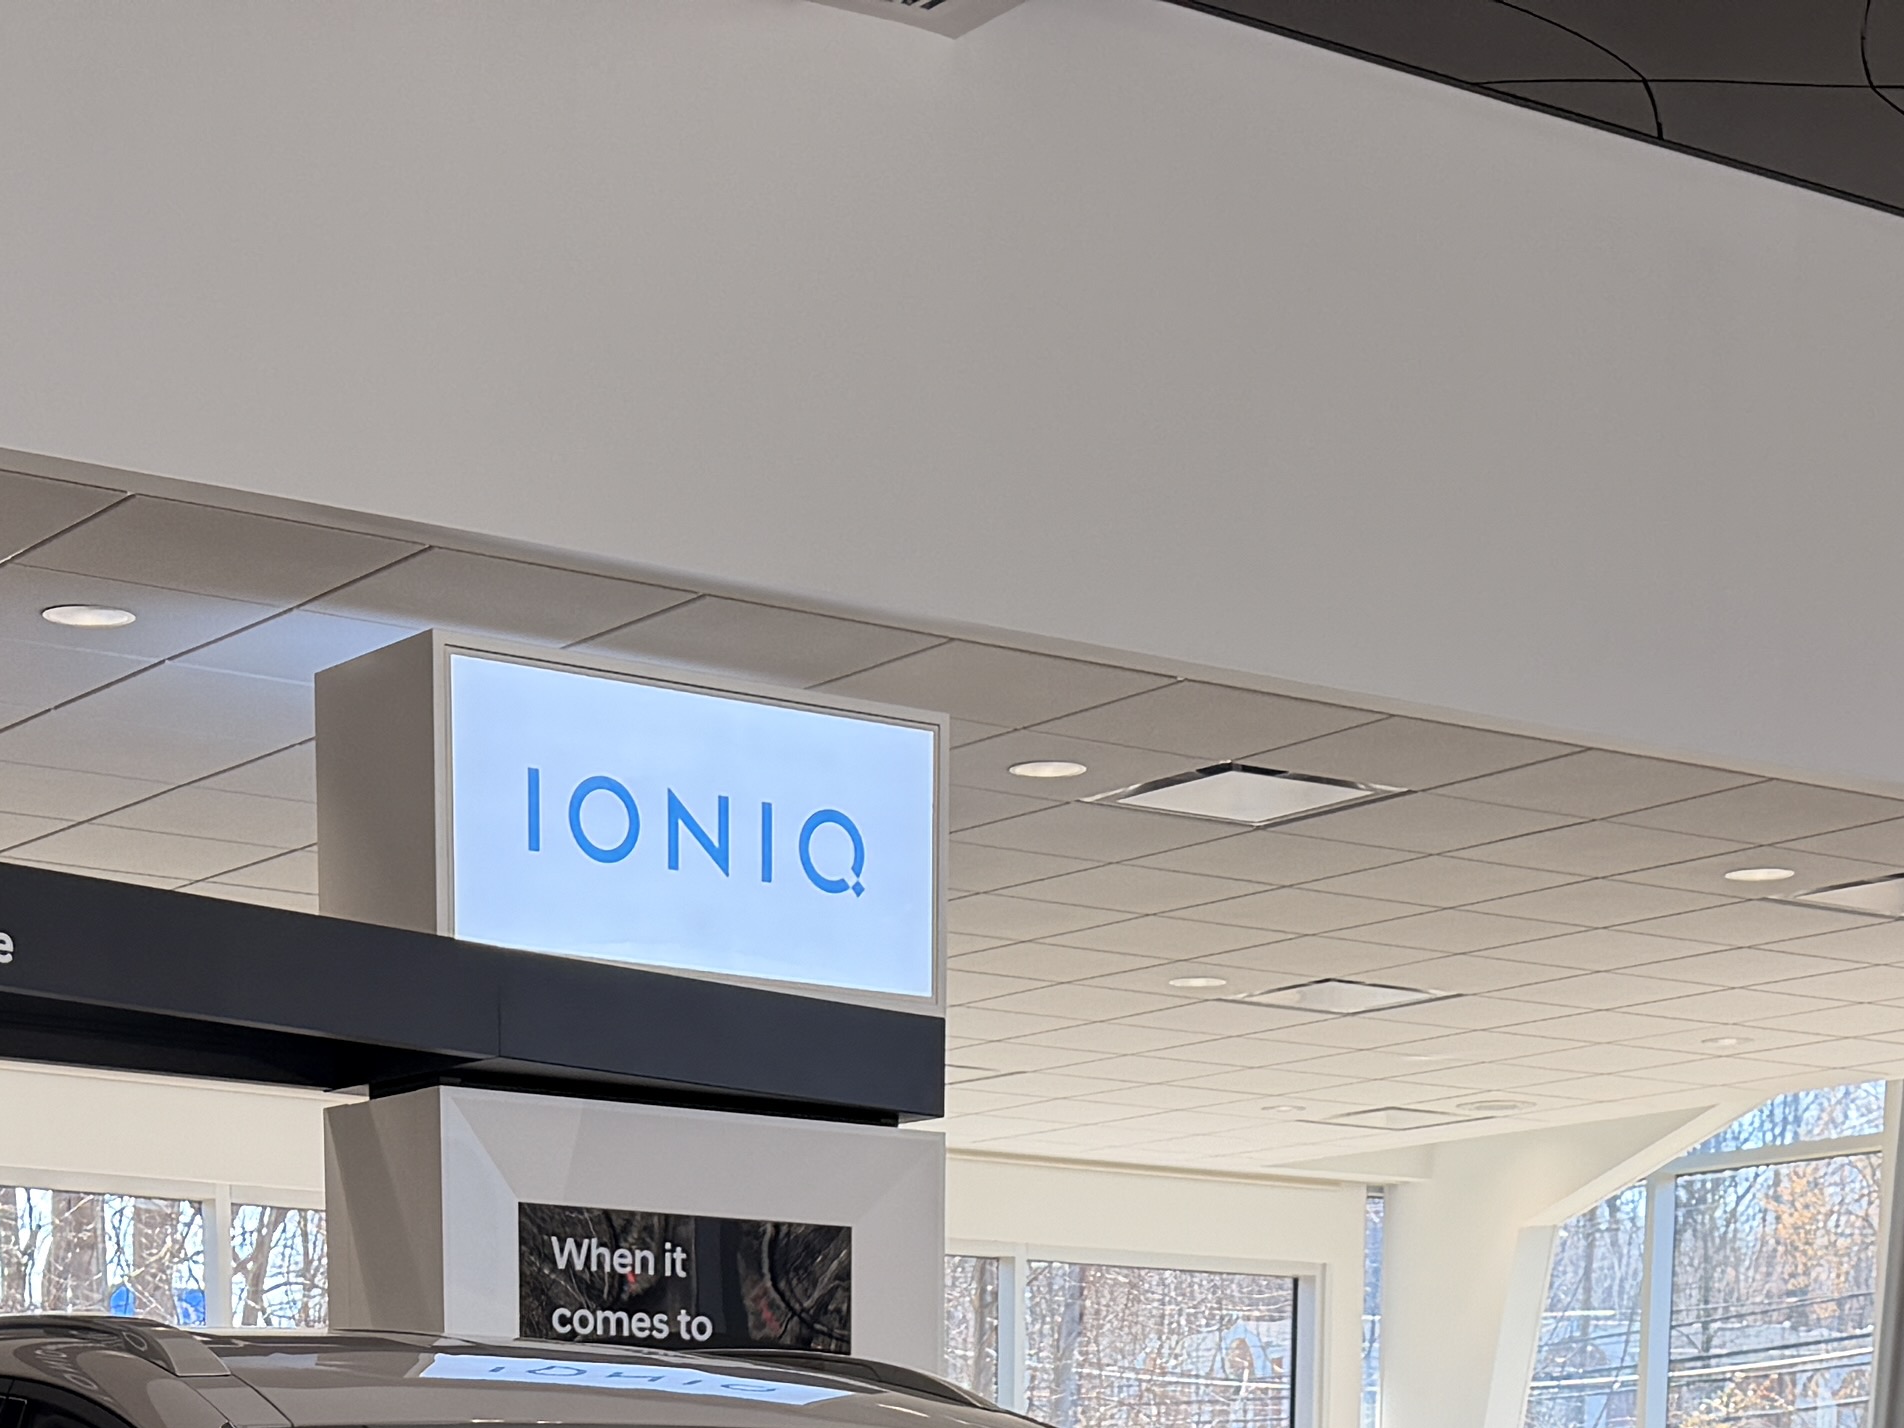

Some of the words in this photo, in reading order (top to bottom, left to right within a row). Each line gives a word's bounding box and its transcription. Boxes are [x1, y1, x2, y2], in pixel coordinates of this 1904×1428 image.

[527, 766, 865, 898] IONIQ
[551, 1235, 655, 1276] When
[664, 1241, 687, 1278] it
[551, 1306, 670, 1339] comes
[677, 1308, 713, 1342] to
